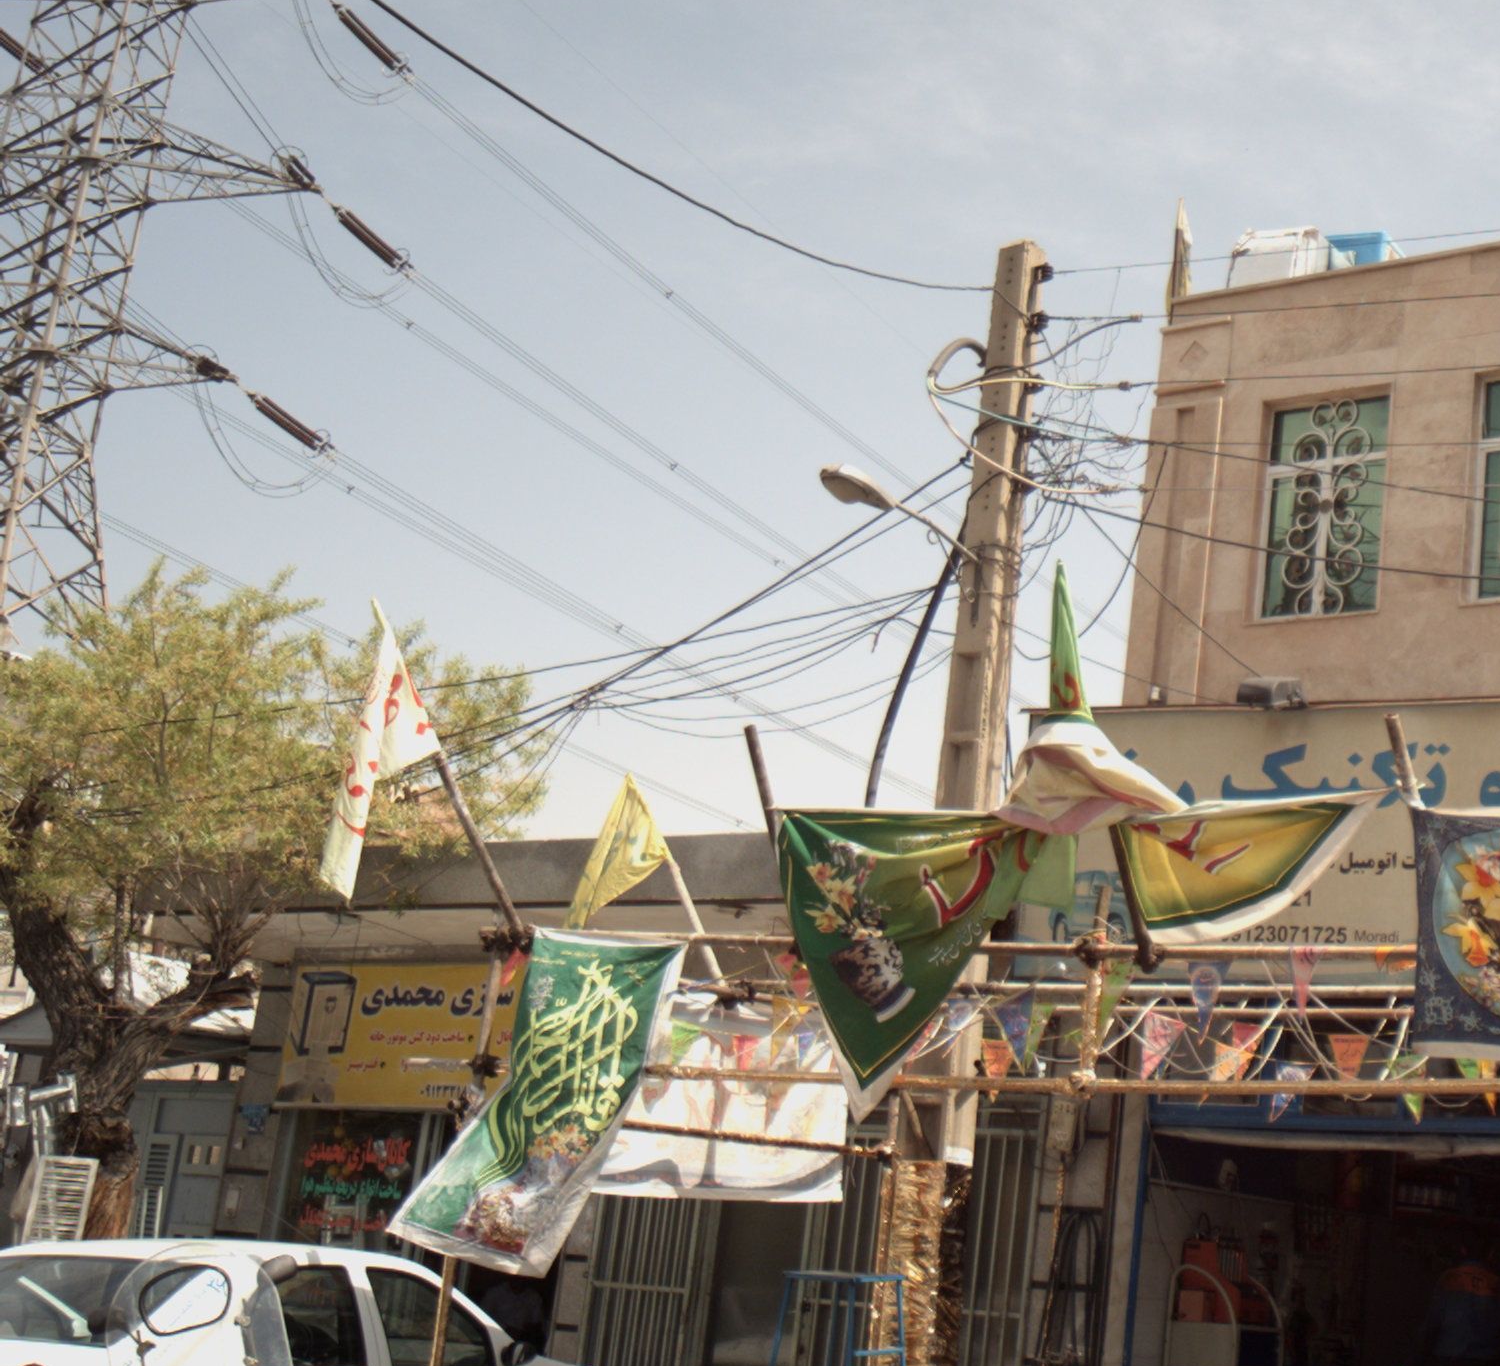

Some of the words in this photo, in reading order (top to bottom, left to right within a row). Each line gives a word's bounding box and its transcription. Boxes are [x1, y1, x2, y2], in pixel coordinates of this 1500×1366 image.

[1339, 852, 1397, 874] اتومبیل
[1354, 930, 1399, 943] Moradi
[361, 984, 445, 1016] محمدی
